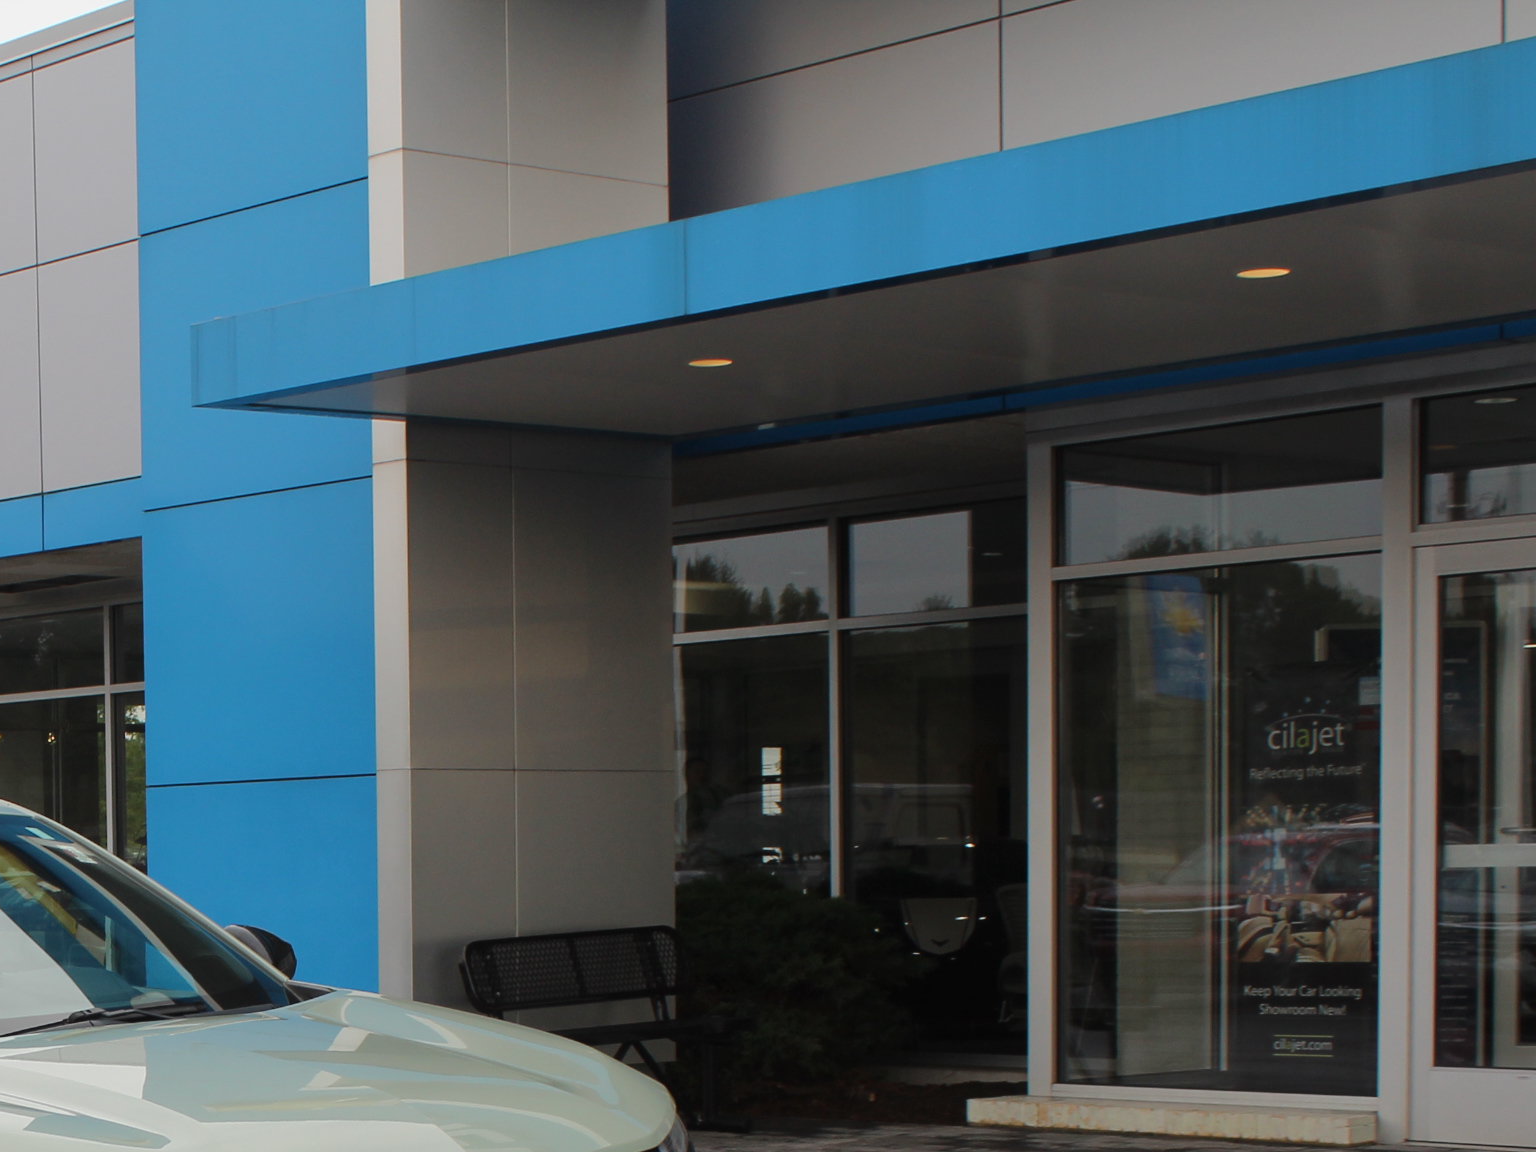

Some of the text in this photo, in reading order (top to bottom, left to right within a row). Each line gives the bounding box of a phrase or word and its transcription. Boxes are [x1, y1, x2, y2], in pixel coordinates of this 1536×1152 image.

[1267, 721, 1345, 755] cilajet
[1249, 767, 1304, 780] Reflecting
[1306, 765, 1325, 777] the
[1243, 985, 1363, 1000] Keep Your Car Looking
[1259, 1003, 1347, 1016] Showroom New!
[1273, 1038, 1333, 1052] cilajet.com
